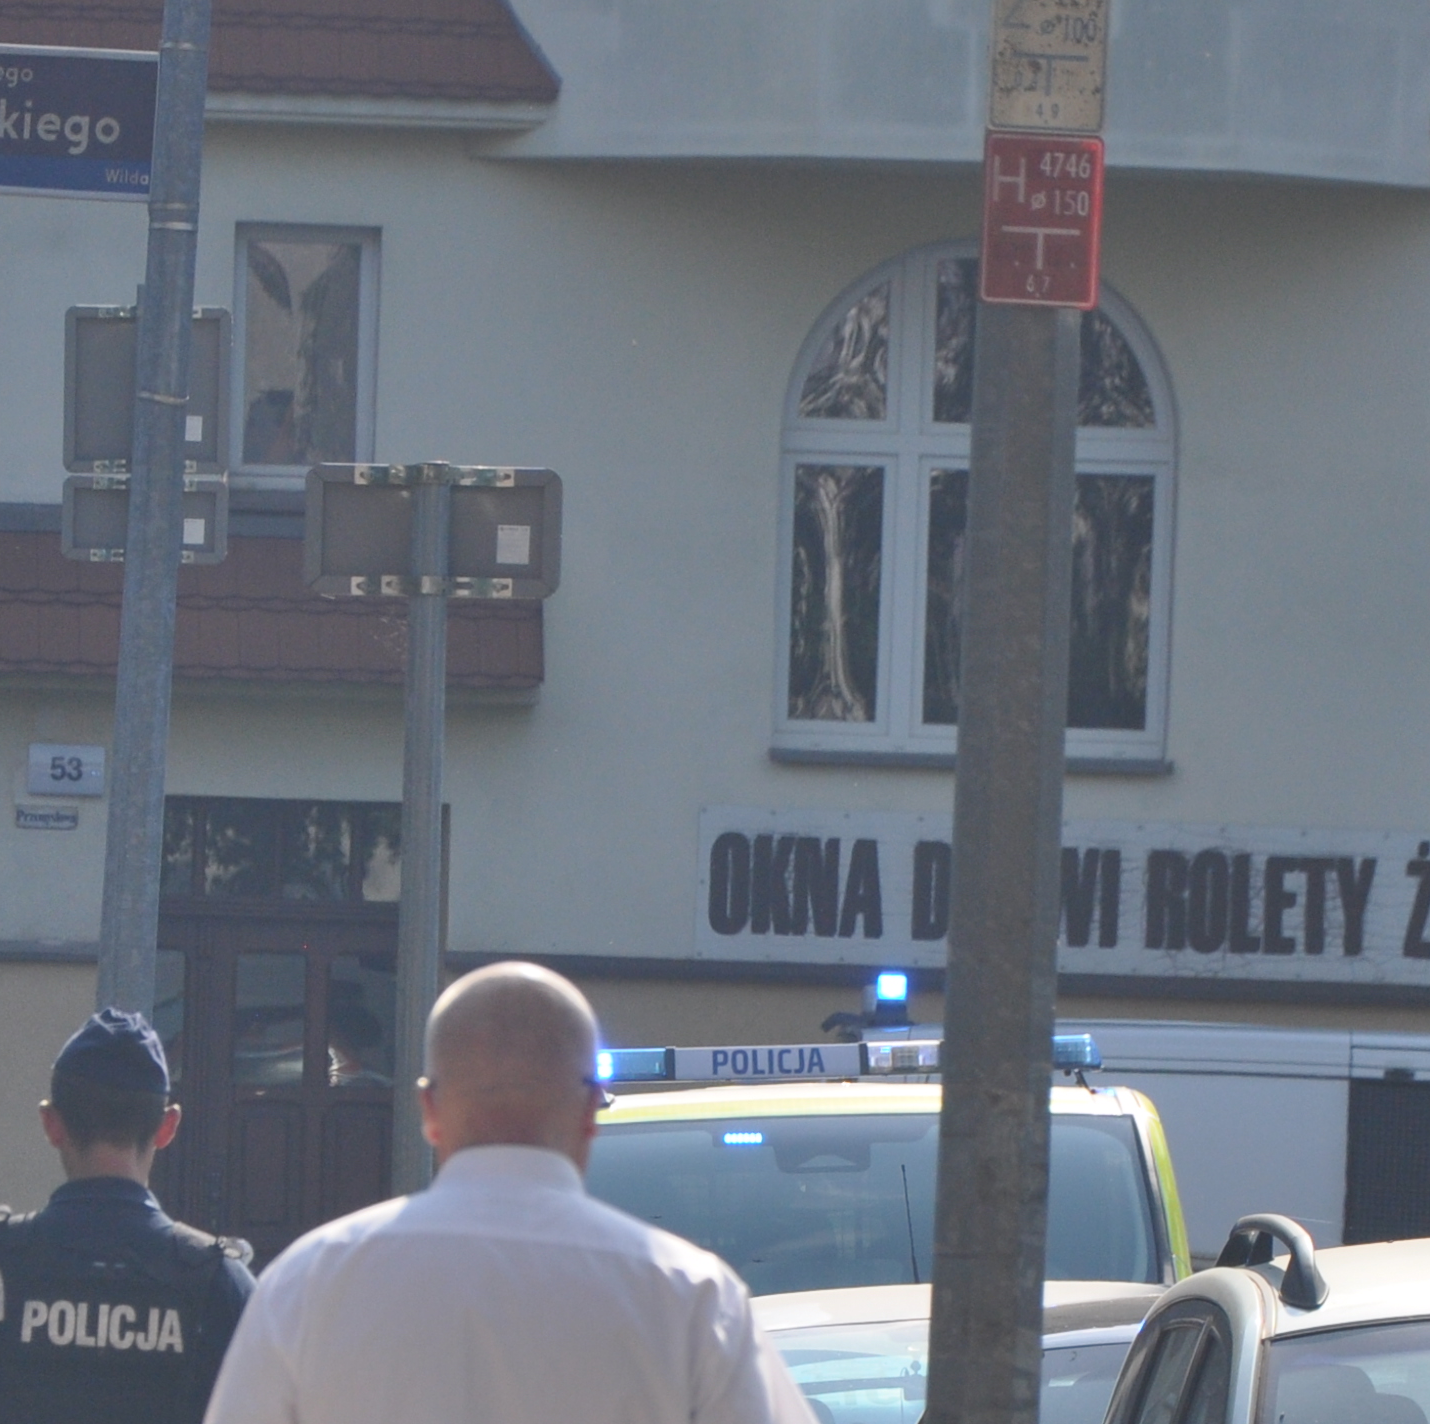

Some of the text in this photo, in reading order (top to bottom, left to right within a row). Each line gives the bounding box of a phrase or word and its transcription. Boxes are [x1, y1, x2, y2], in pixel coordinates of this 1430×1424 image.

[105, 168, 150, 185] Wilda
[993, 155, 1026, 203] H
[1040, 152, 1091, 179] 4746
[50, 756, 83, 782] 53
[708, 831, 883, 938] OKNA
[911, 840, 1120, 948] DWI
[1143, 848, 1377, 957] ROLETY
[712, 1046, 826, 1076] POLICJA
[21, 1299, 184, 1354] POLICJA
